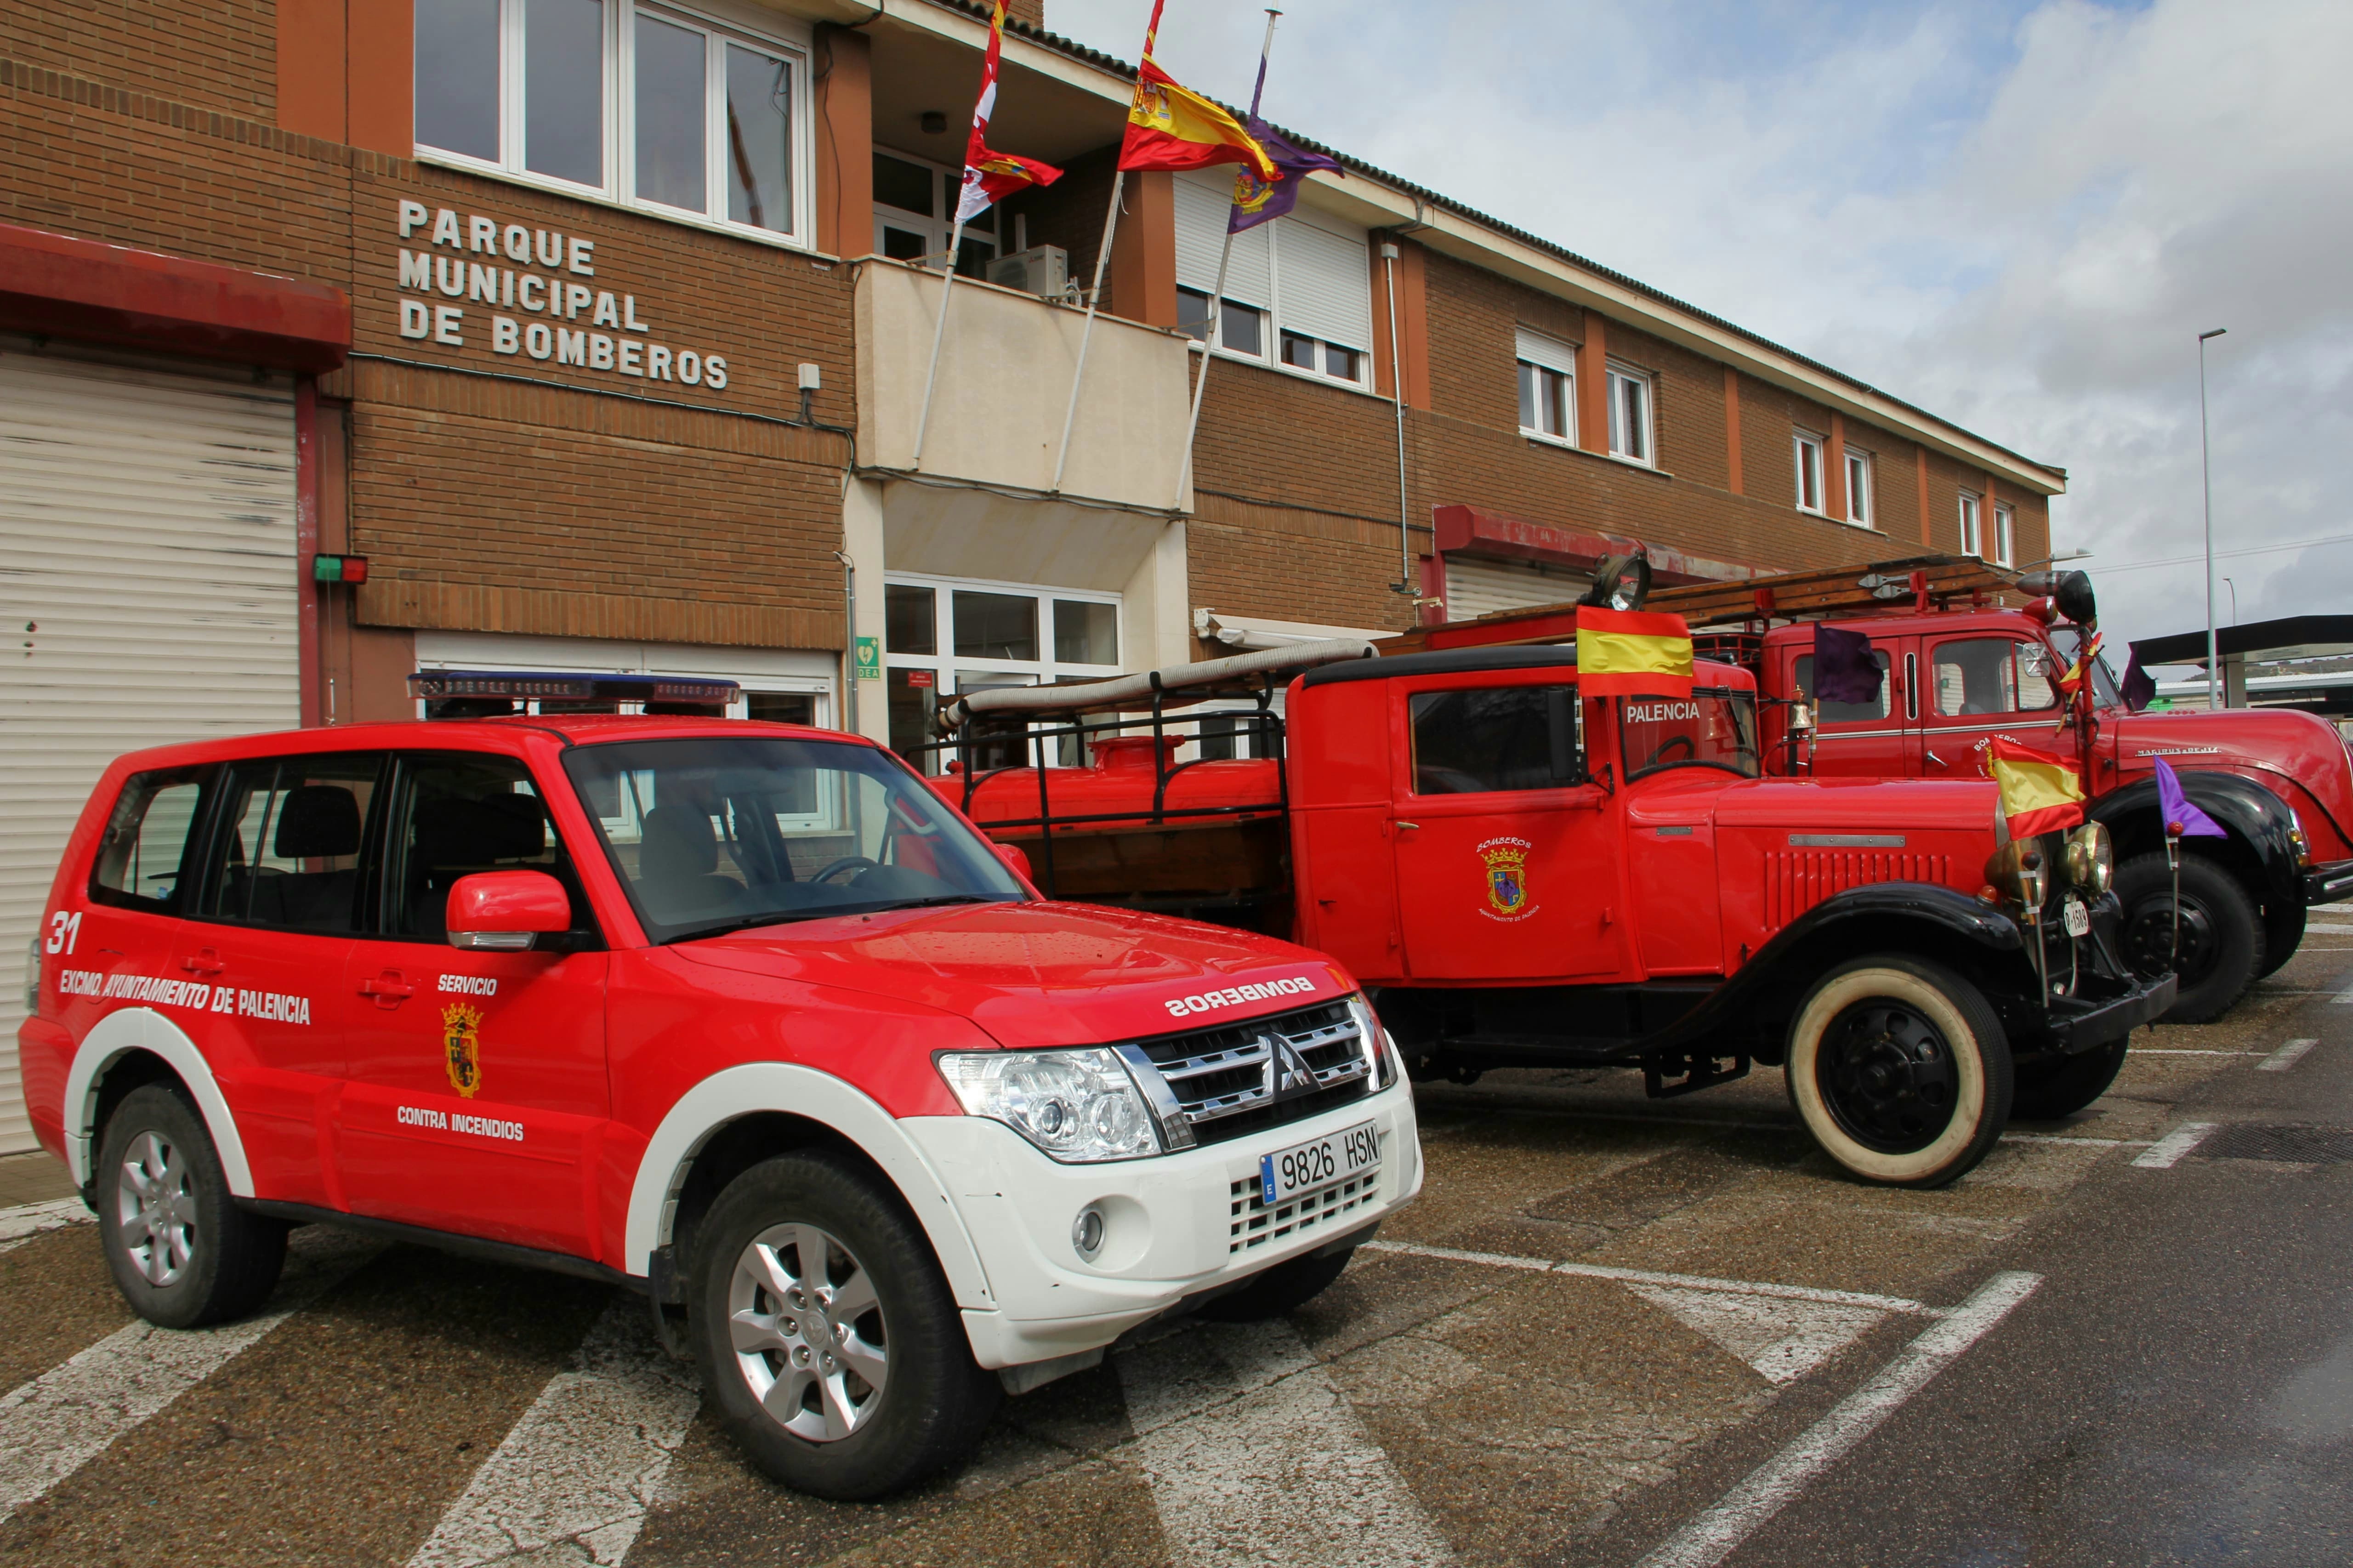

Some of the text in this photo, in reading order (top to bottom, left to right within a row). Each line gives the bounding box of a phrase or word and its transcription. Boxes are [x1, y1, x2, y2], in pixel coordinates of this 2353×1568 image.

[398, 199, 594, 276] PARQUE
[398, 249, 648, 332] MUNICIPAL
[400, 299, 727, 390] DE BOMBEROS
[858, 669, 879, 677] DEA
[1627, 702, 1700, 723] PALENCIA
[1476, 837, 1531, 852] BOMBEROS
[46, 911, 82, 955] 31
[60, 969, 310, 1024] EXCMO. AYUNTAMIENTO DE PALENCIA
[438, 974, 497, 996] SERVICIO
[398, 1106, 523, 1141] CONTRA INCENDIOS
[1281, 1126, 1379, 1190] 9826 HSN
[1267, 1184, 1273, 1194] E
